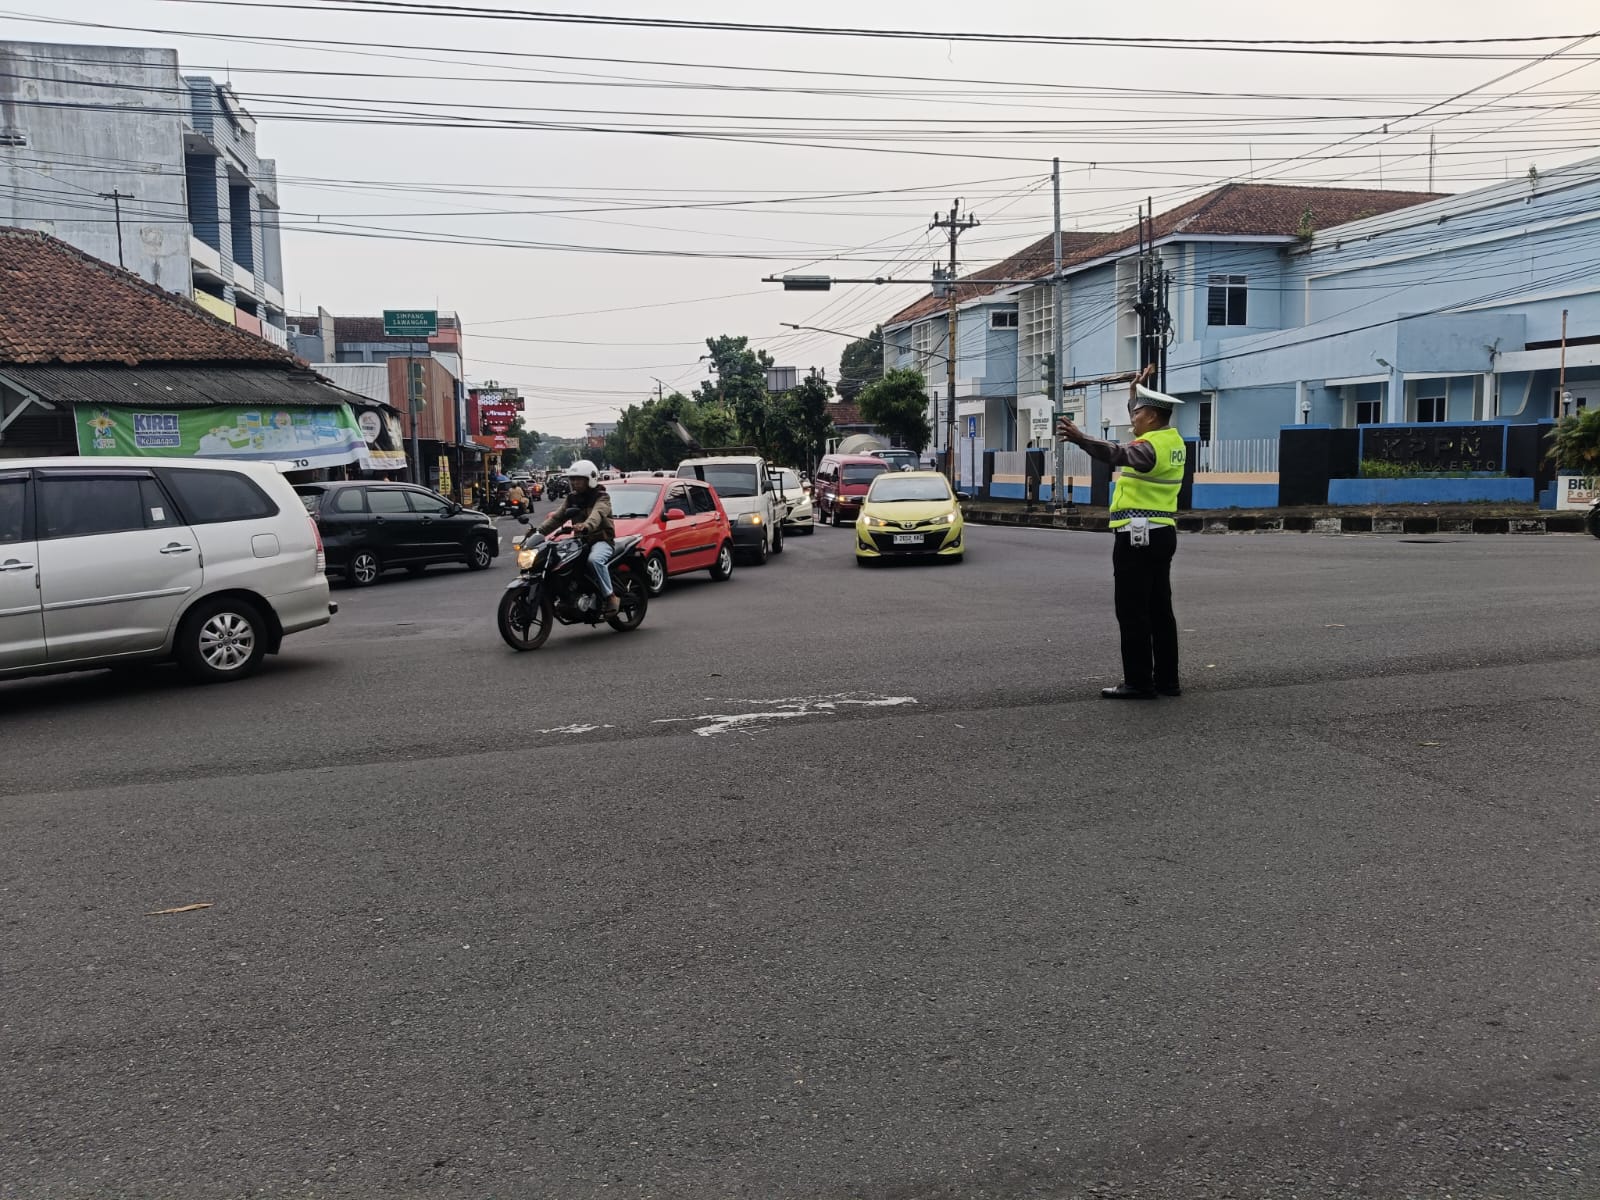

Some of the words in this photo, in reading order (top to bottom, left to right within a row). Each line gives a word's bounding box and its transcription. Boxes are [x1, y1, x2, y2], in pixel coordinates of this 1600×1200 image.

[135, 415, 178, 431] KIREI
[294, 459, 309, 468] TO
[1171, 450, 1185, 464] PO
